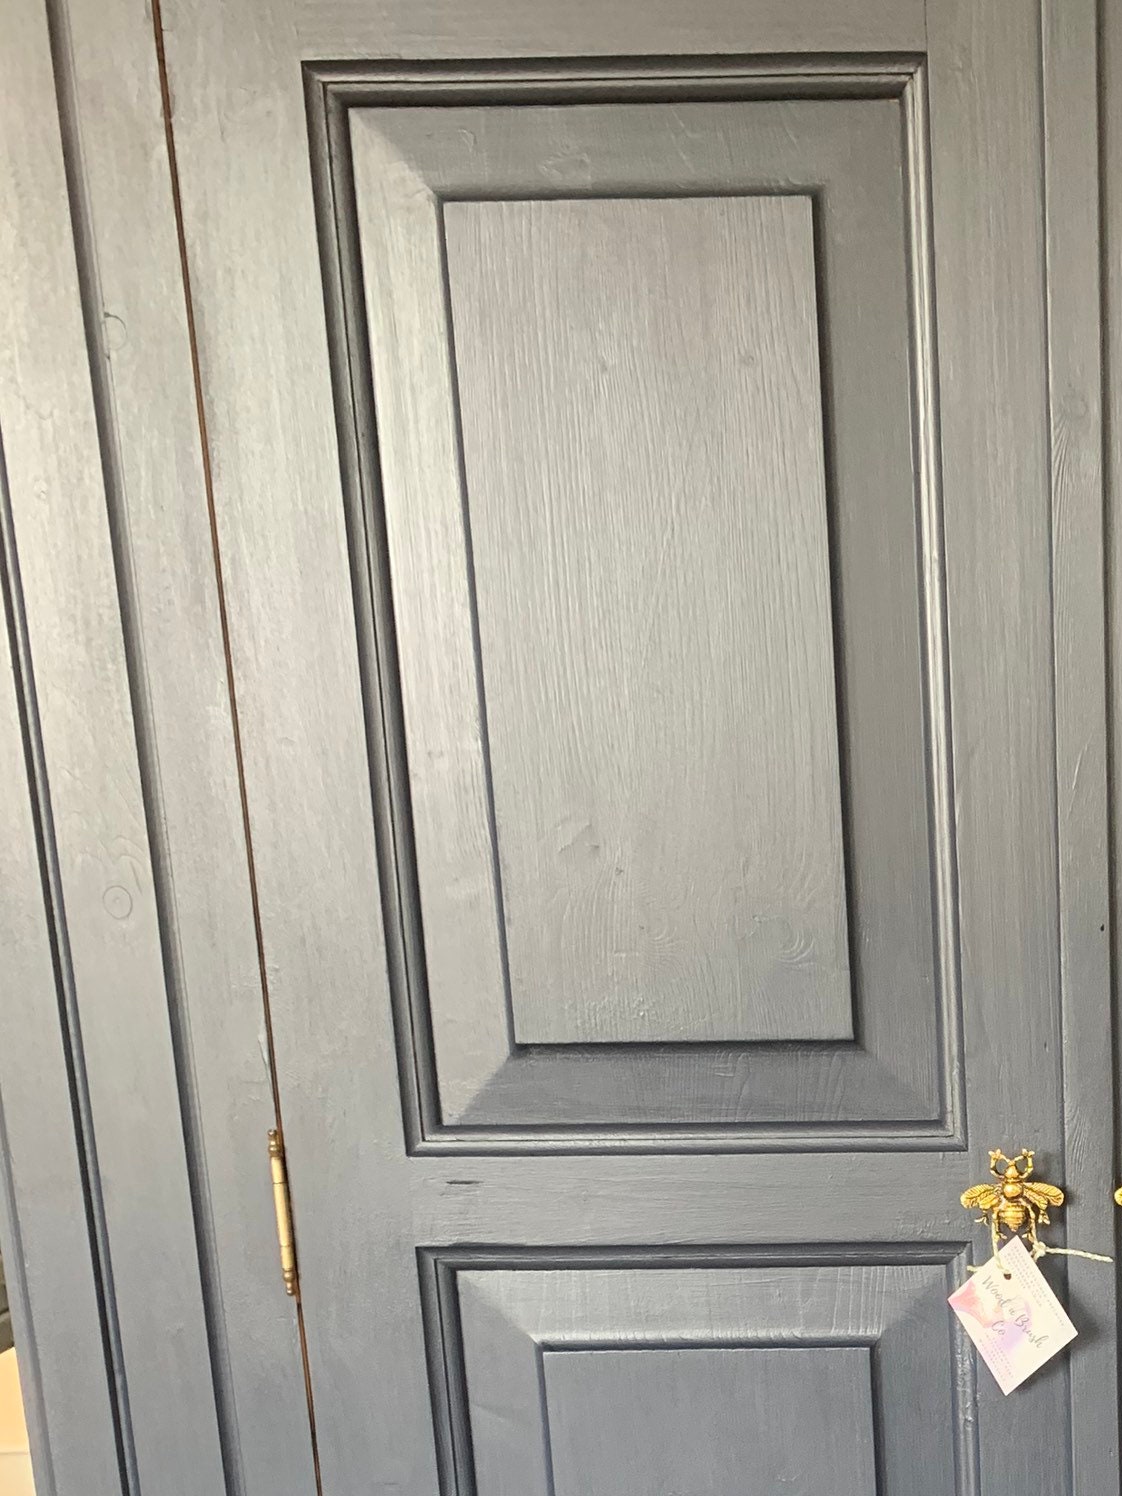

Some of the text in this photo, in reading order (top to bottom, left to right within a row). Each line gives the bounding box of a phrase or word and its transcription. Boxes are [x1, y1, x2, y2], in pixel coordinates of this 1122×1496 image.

[982, 1275, 1012, 1308] Wood
[1014, 1313, 1050, 1348] Brush
[991, 1320, 1006, 1336] Co
